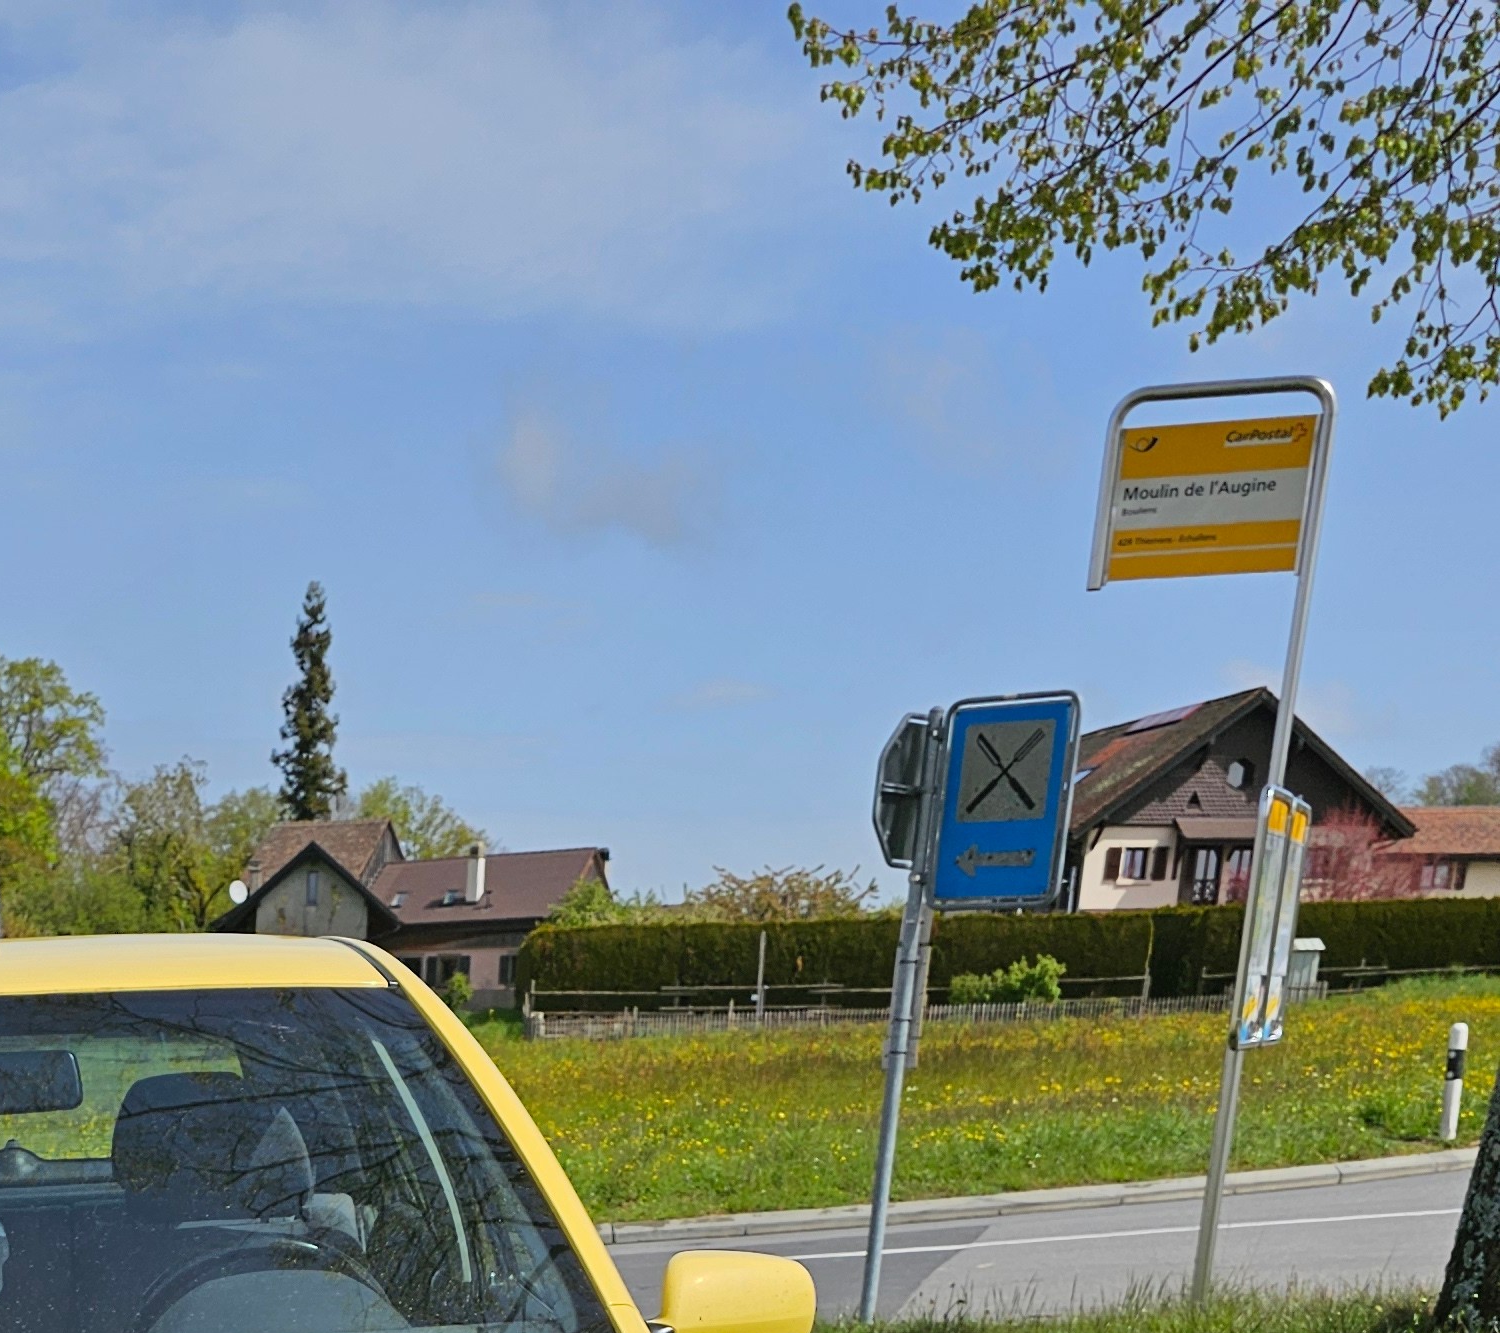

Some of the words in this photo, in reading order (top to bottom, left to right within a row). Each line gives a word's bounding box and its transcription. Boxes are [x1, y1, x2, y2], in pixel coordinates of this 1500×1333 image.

[1122, 483, 1179, 501] Moulin
[1184, 482, 1204, 497] de
[1209, 478, 1277, 497] l'Augine
